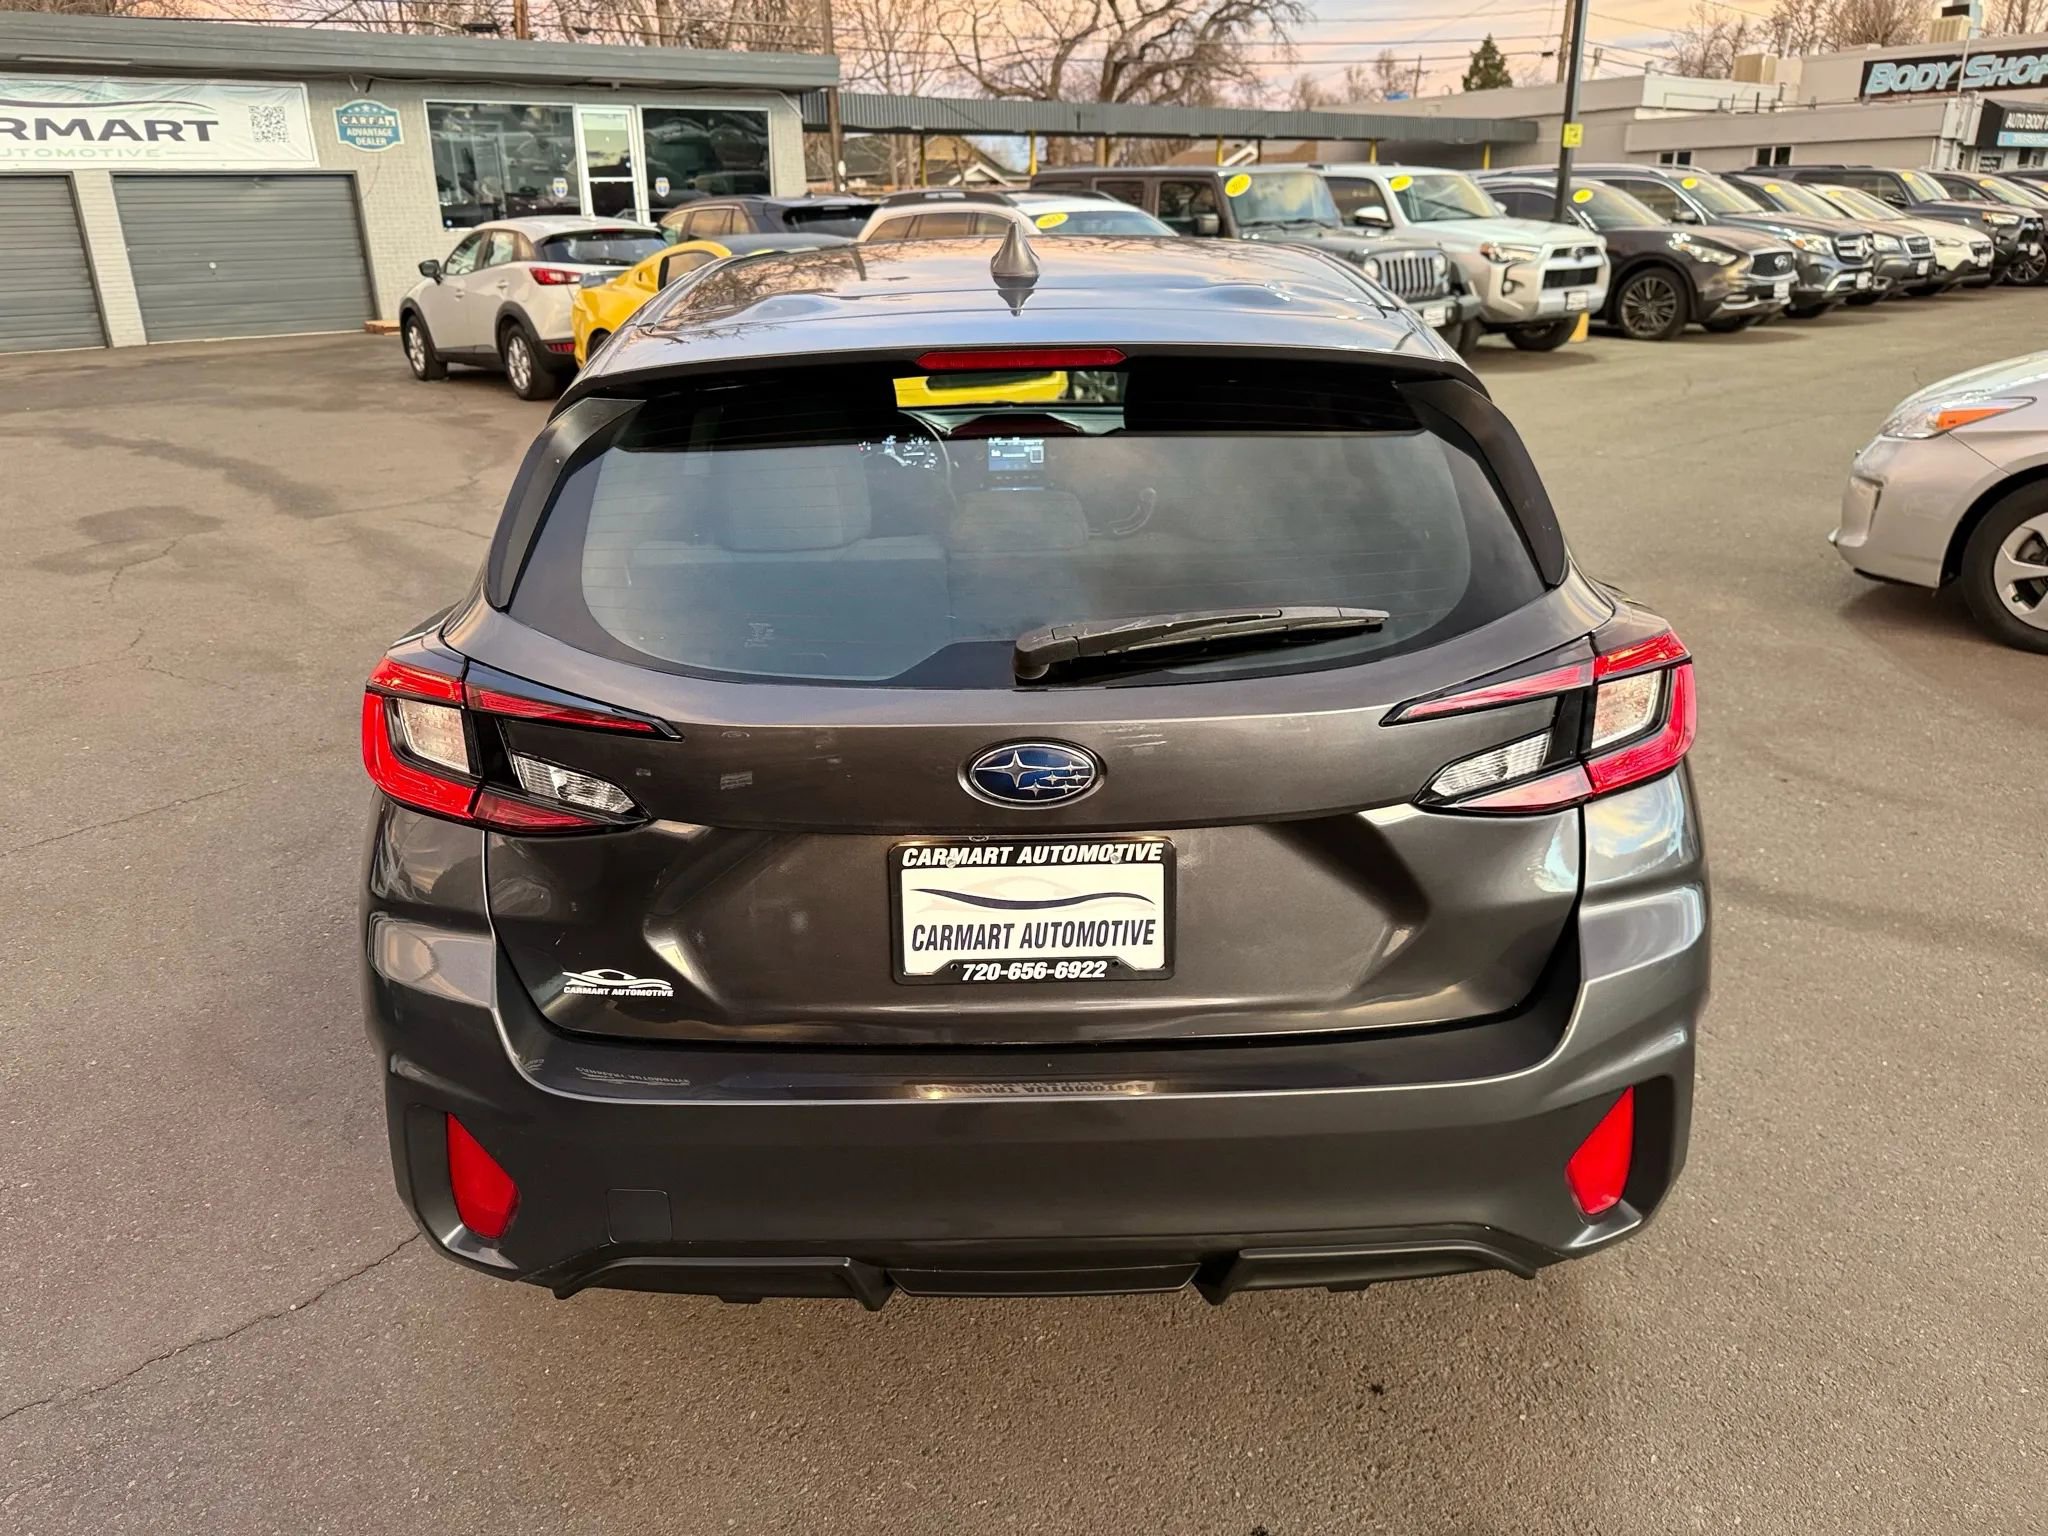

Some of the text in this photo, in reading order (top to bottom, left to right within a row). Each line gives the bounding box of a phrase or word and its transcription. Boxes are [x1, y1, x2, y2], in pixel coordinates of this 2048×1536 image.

[1866, 54, 2048, 94] BODY SHOP
[0, 117, 219, 142] RMART
[2005, 112, 2026, 129] AUTO
[2025, 113, 2044, 130] BODY
[346, 127, 394, 137] ADVANTAGE
[355, 136, 388, 146] DEALER
[902, 843, 1164, 867] CARMART AUTOMOTIVE
[911, 919, 1157, 951] CARMART AUTOMOTIVE
[962, 960, 1108, 981] 720-656-6922
[563, 986, 674, 997] CARMART AUTOMOTIVE
